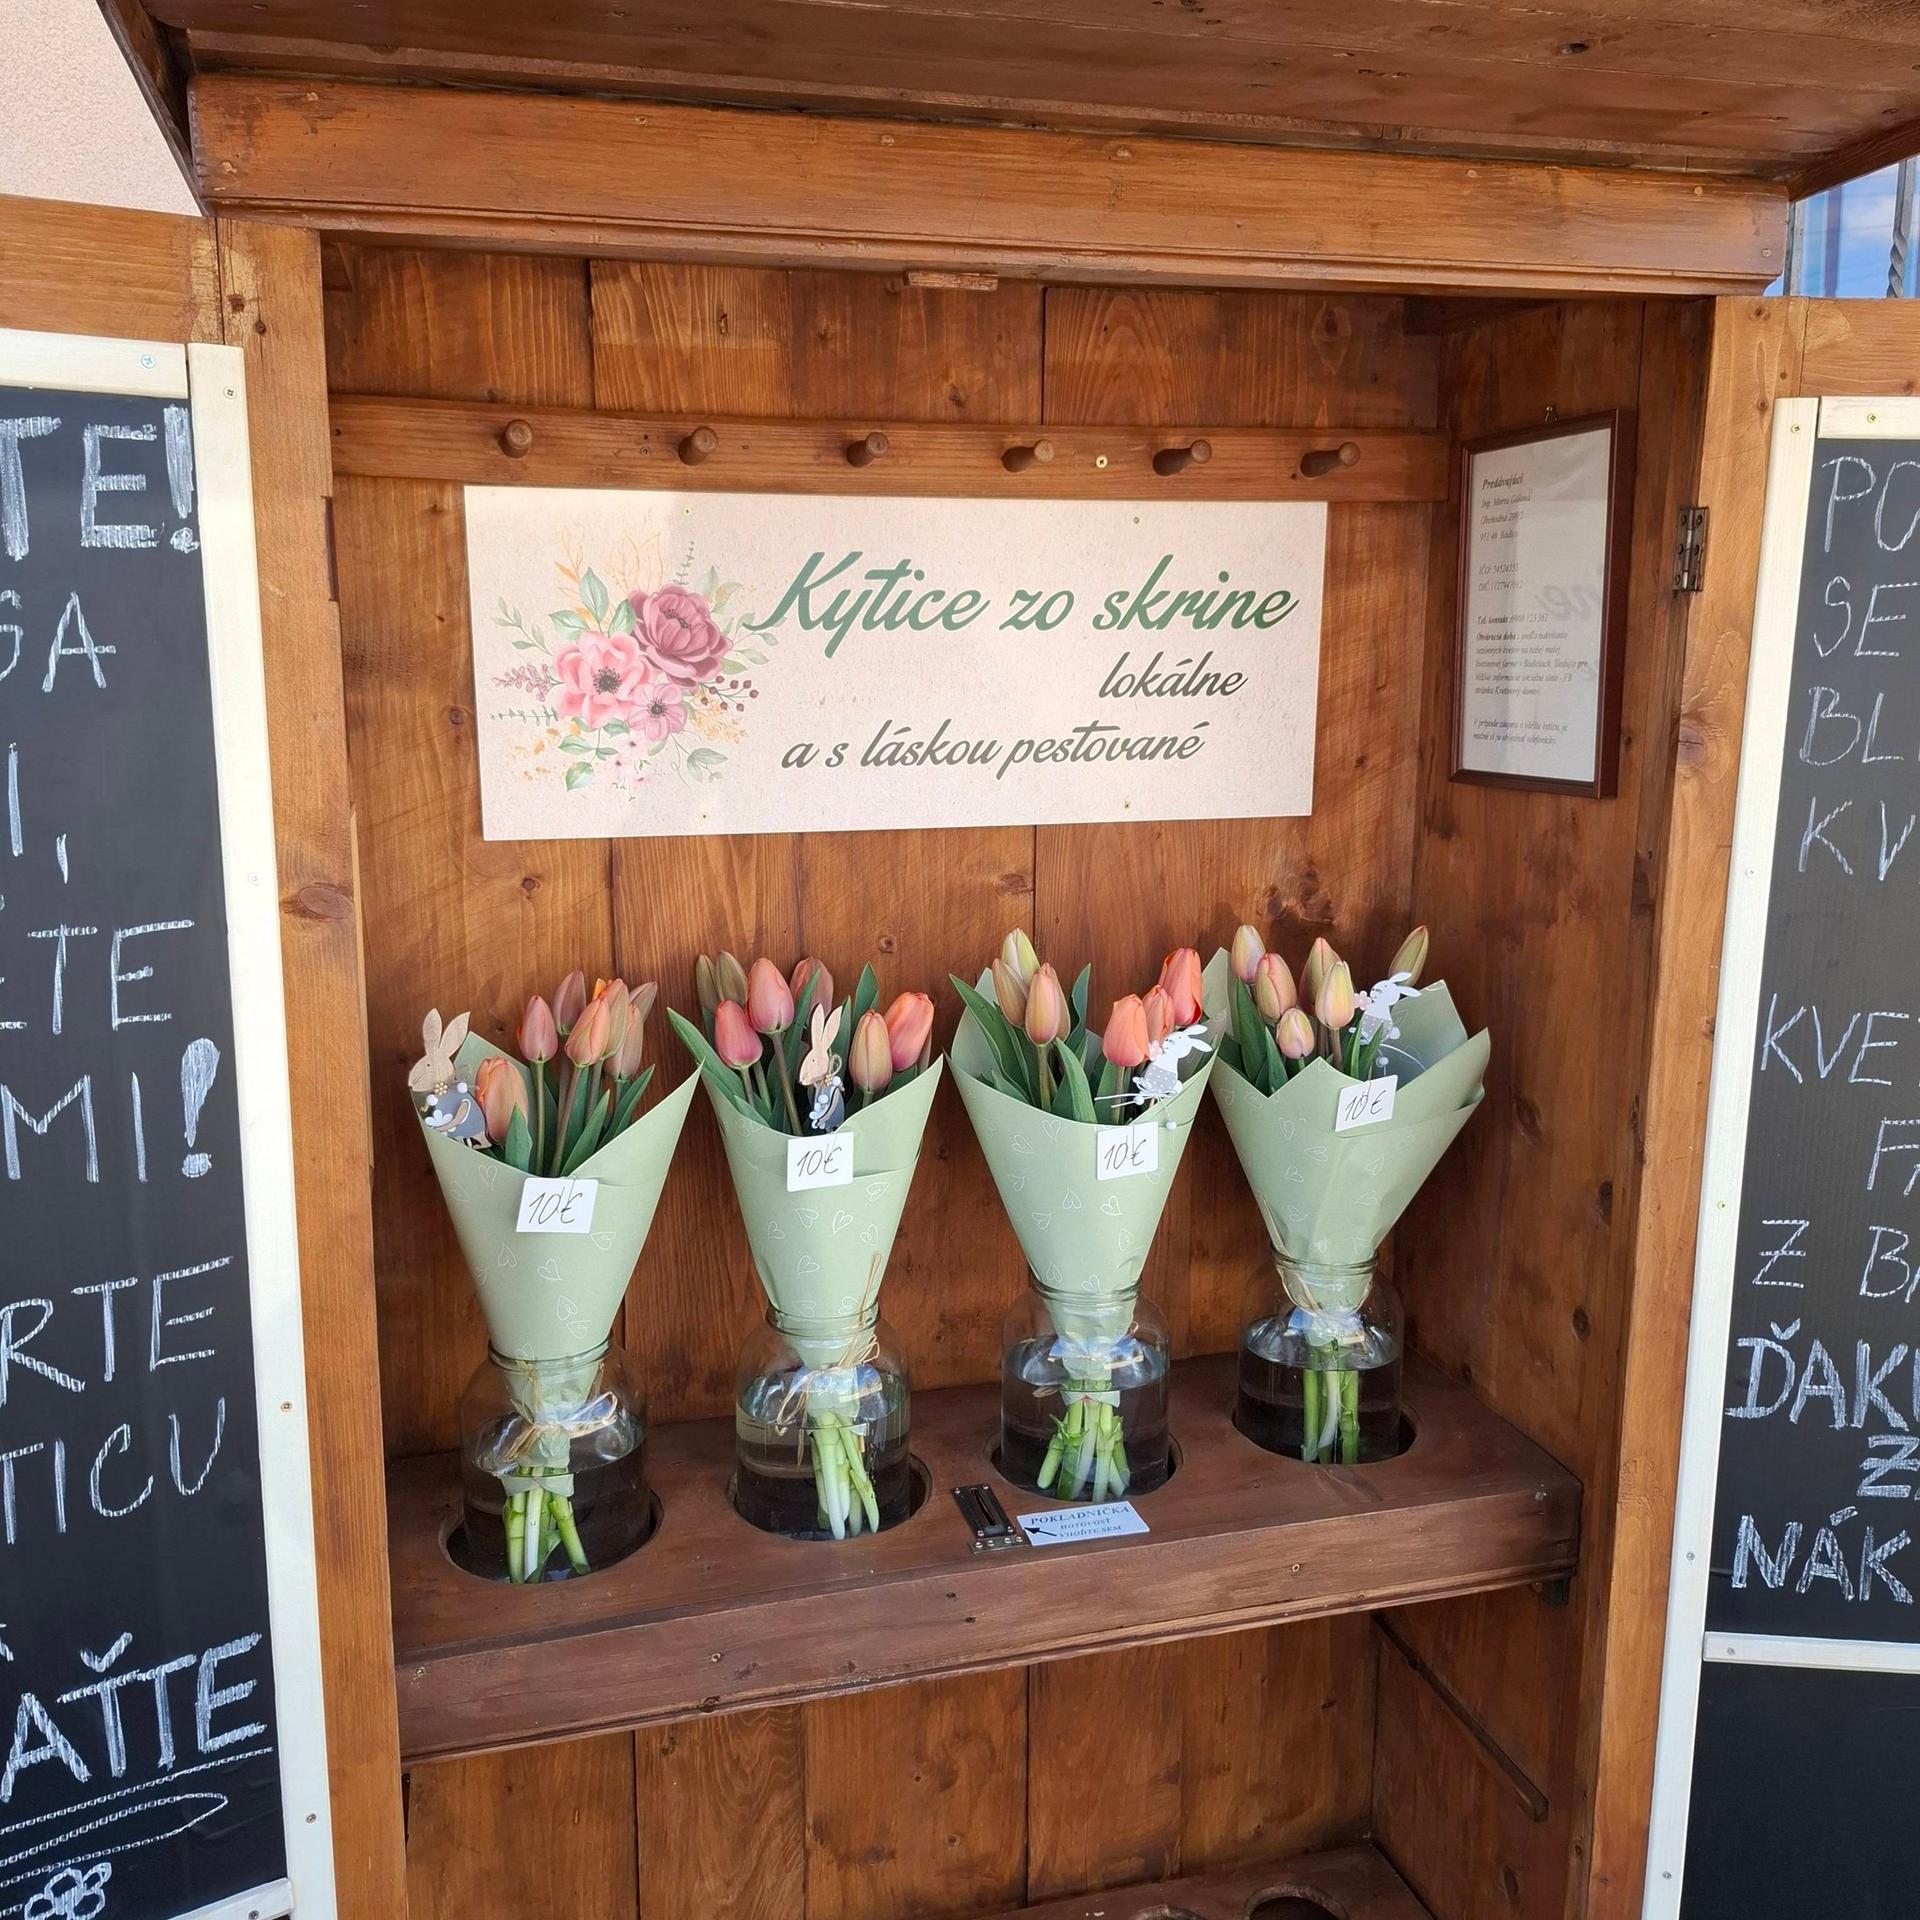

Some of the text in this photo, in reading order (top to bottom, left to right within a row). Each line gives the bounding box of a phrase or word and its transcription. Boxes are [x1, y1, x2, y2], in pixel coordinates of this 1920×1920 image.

[743, 550, 1299, 660] Kytice zo skrine
[1098, 651, 1248, 699] lokálne
[781, 719, 1211, 781] a s láskou pestované
[0, 922, 195, 1035] TE
[1344, 1089, 1388, 1123] 10€
[797, 1146, 843, 1178] 10€
[1103, 1137, 1147, 1171] 10€
[528, 1190, 583, 1225] 10€
[1724, 1317, 1920, 1432] ĎAK
[1031, 1506, 1131, 1525] POKLADNIČKA
